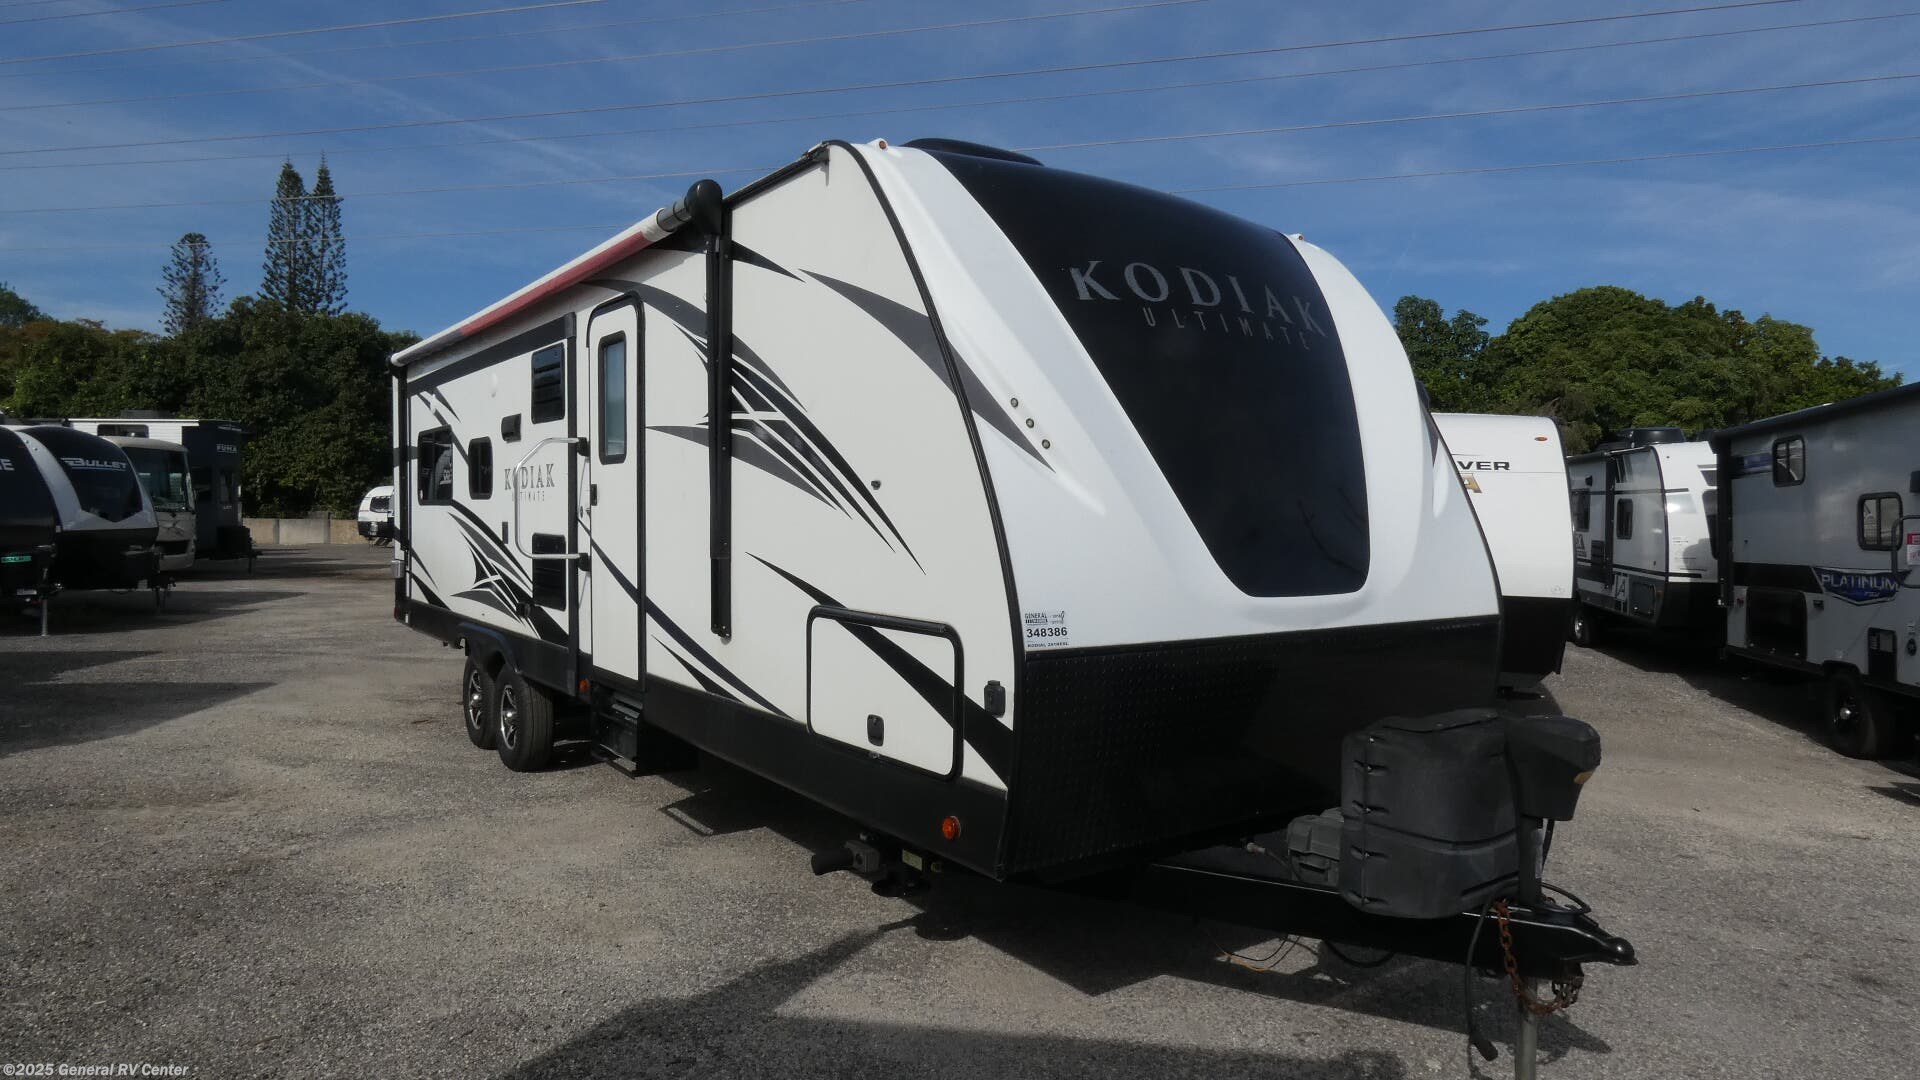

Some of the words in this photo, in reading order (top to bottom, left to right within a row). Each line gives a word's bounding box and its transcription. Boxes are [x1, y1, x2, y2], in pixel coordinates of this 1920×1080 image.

[1069, 260, 1327, 338] KODIAK
[1142, 306, 1311, 350] ULTIMATE
[60, 457, 127, 470] BULLET
[1457, 461, 1511, 471] VER
[1821, 574, 1898, 591] PLATINUM
[1026, 627, 1068, 638] 348386
